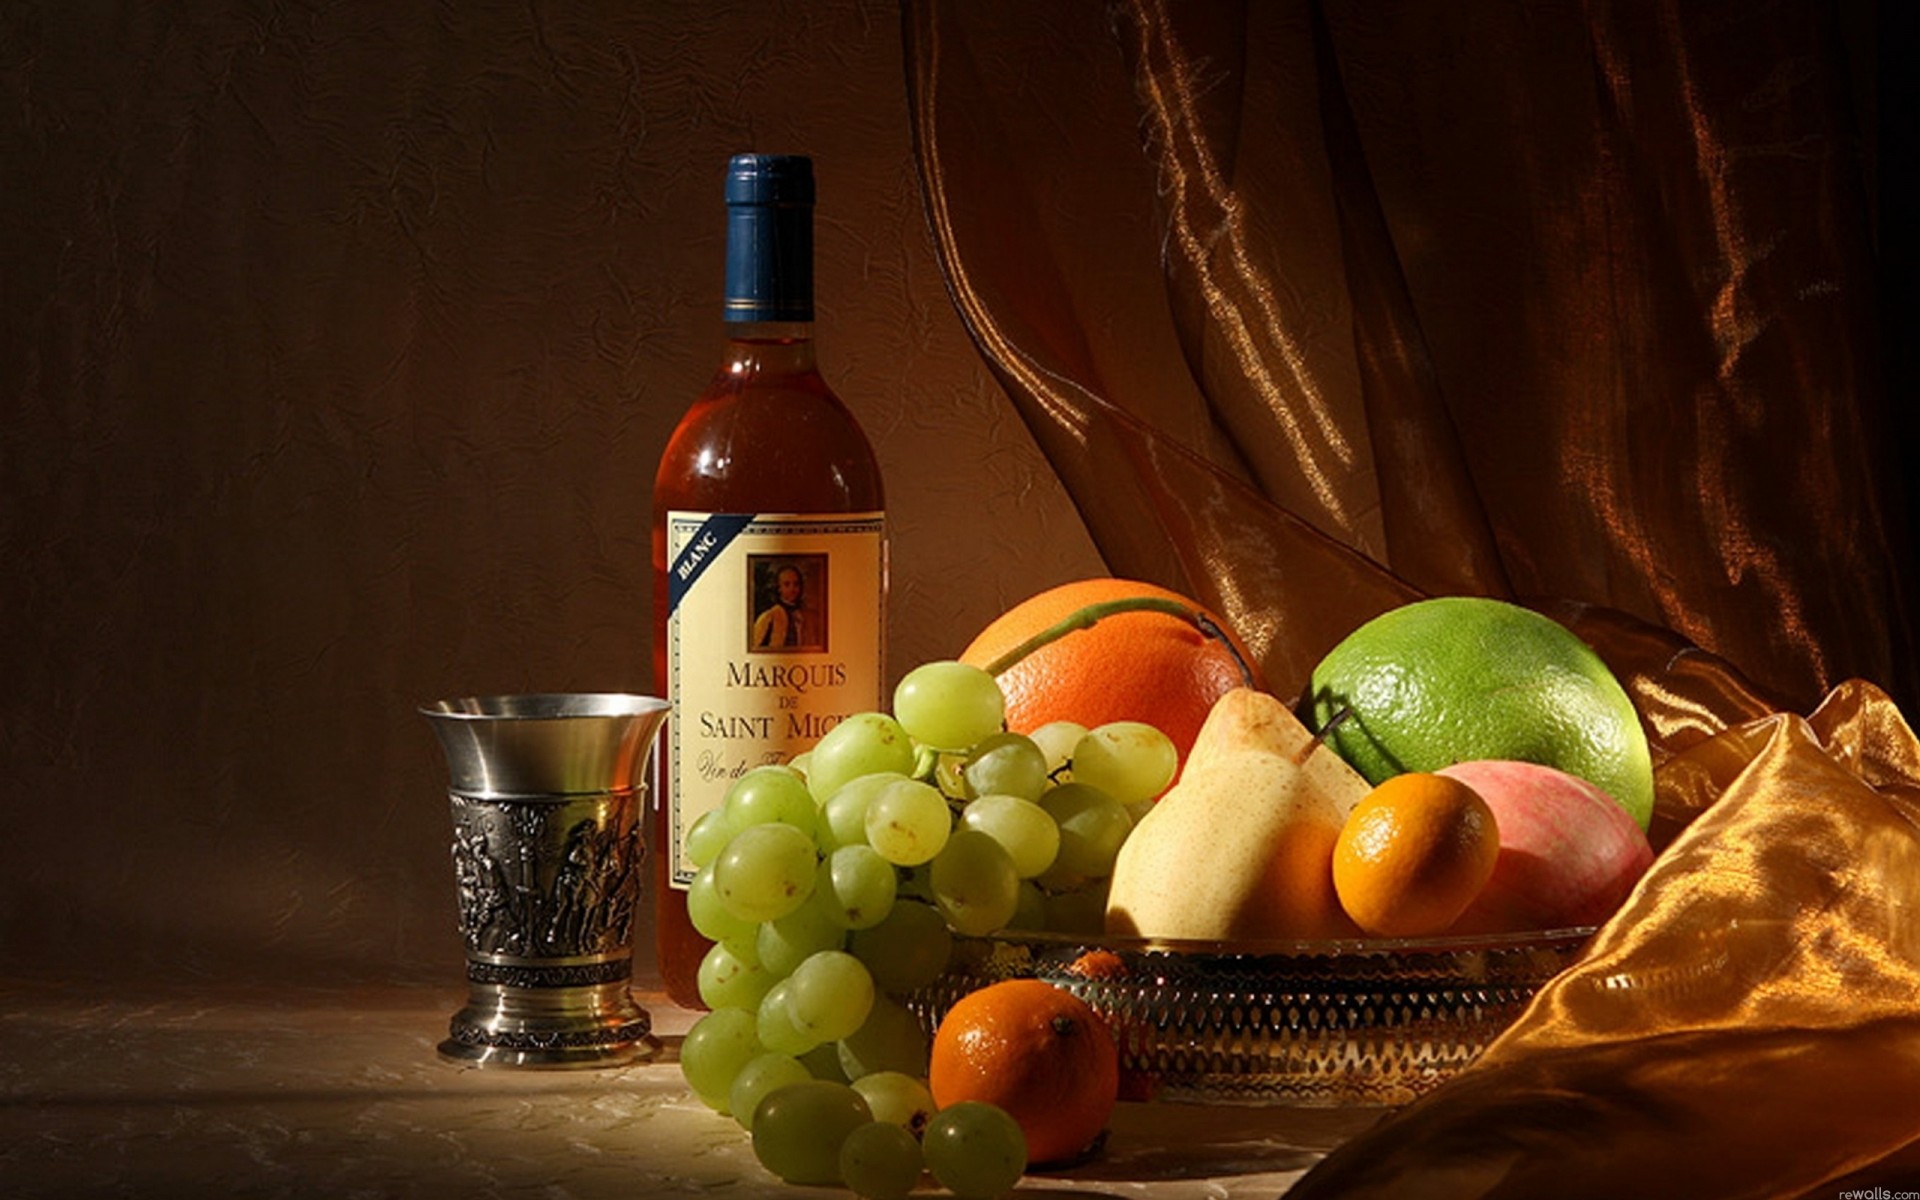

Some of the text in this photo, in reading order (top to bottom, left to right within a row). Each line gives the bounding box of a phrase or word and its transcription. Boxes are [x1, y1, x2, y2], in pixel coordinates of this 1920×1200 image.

[677, 531, 717, 581] BLANC
[726, 662, 847, 693] MARQUIS
[779, 696, 799, 709] DE
[700, 711, 774, 739] SAINT
[697, 750, 726, 782] Vin
